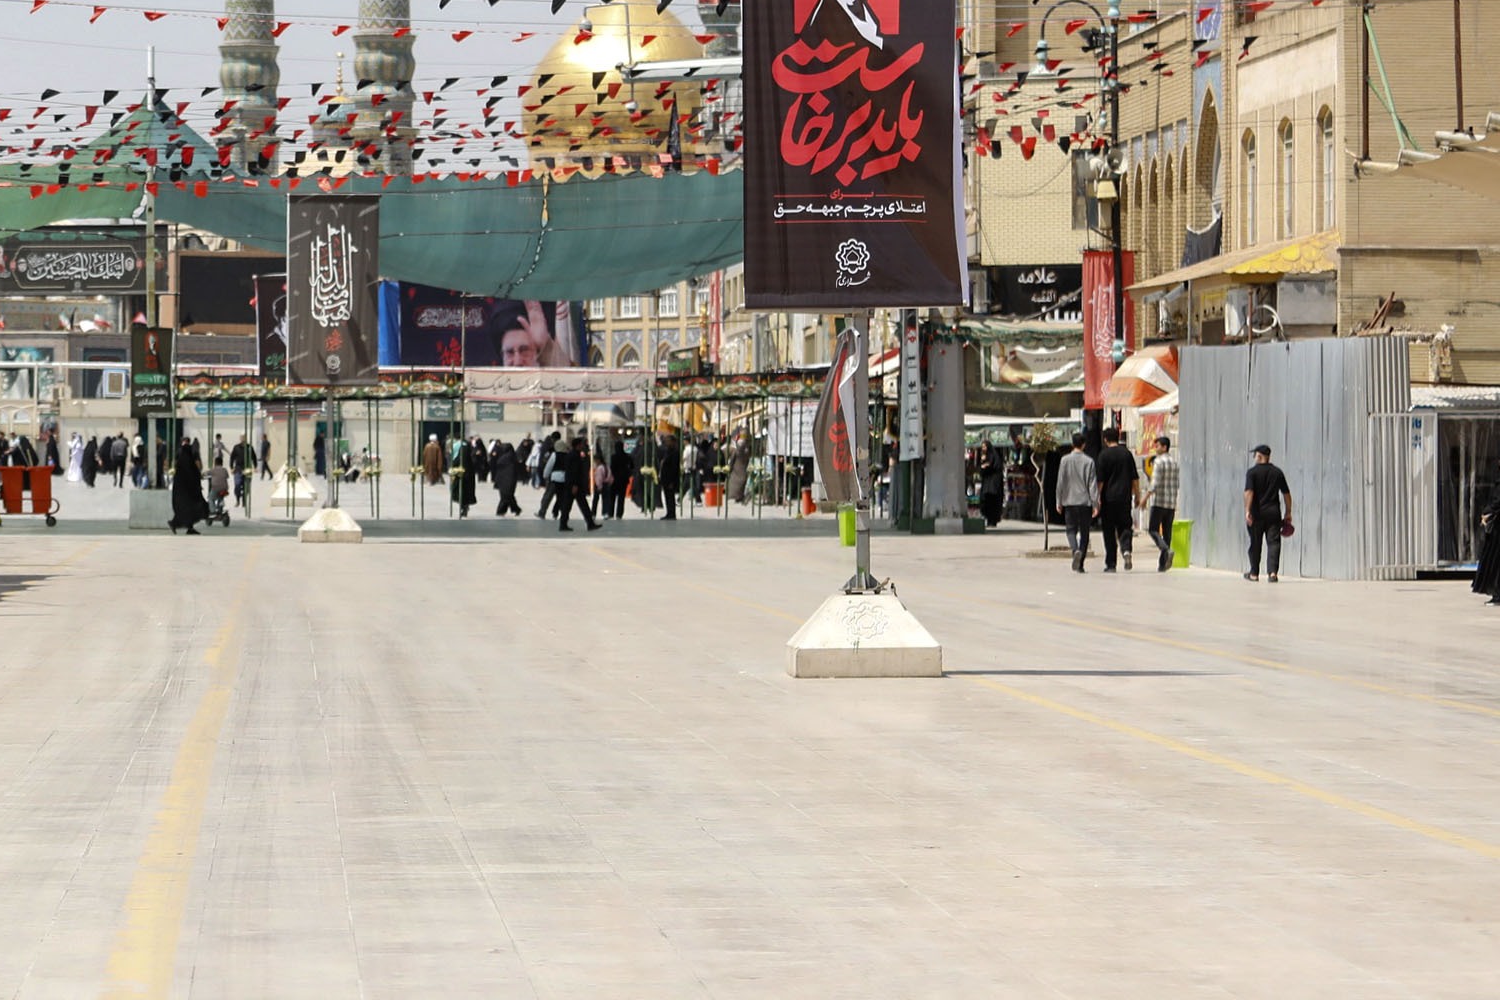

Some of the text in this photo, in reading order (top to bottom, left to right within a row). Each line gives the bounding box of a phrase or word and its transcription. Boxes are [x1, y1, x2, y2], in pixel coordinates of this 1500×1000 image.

[829, 188, 875, 200] برای
[773, 200, 926, 218] اعتلای پرچم جبهه حق
[1017, 267, 1057, 284] علامه
